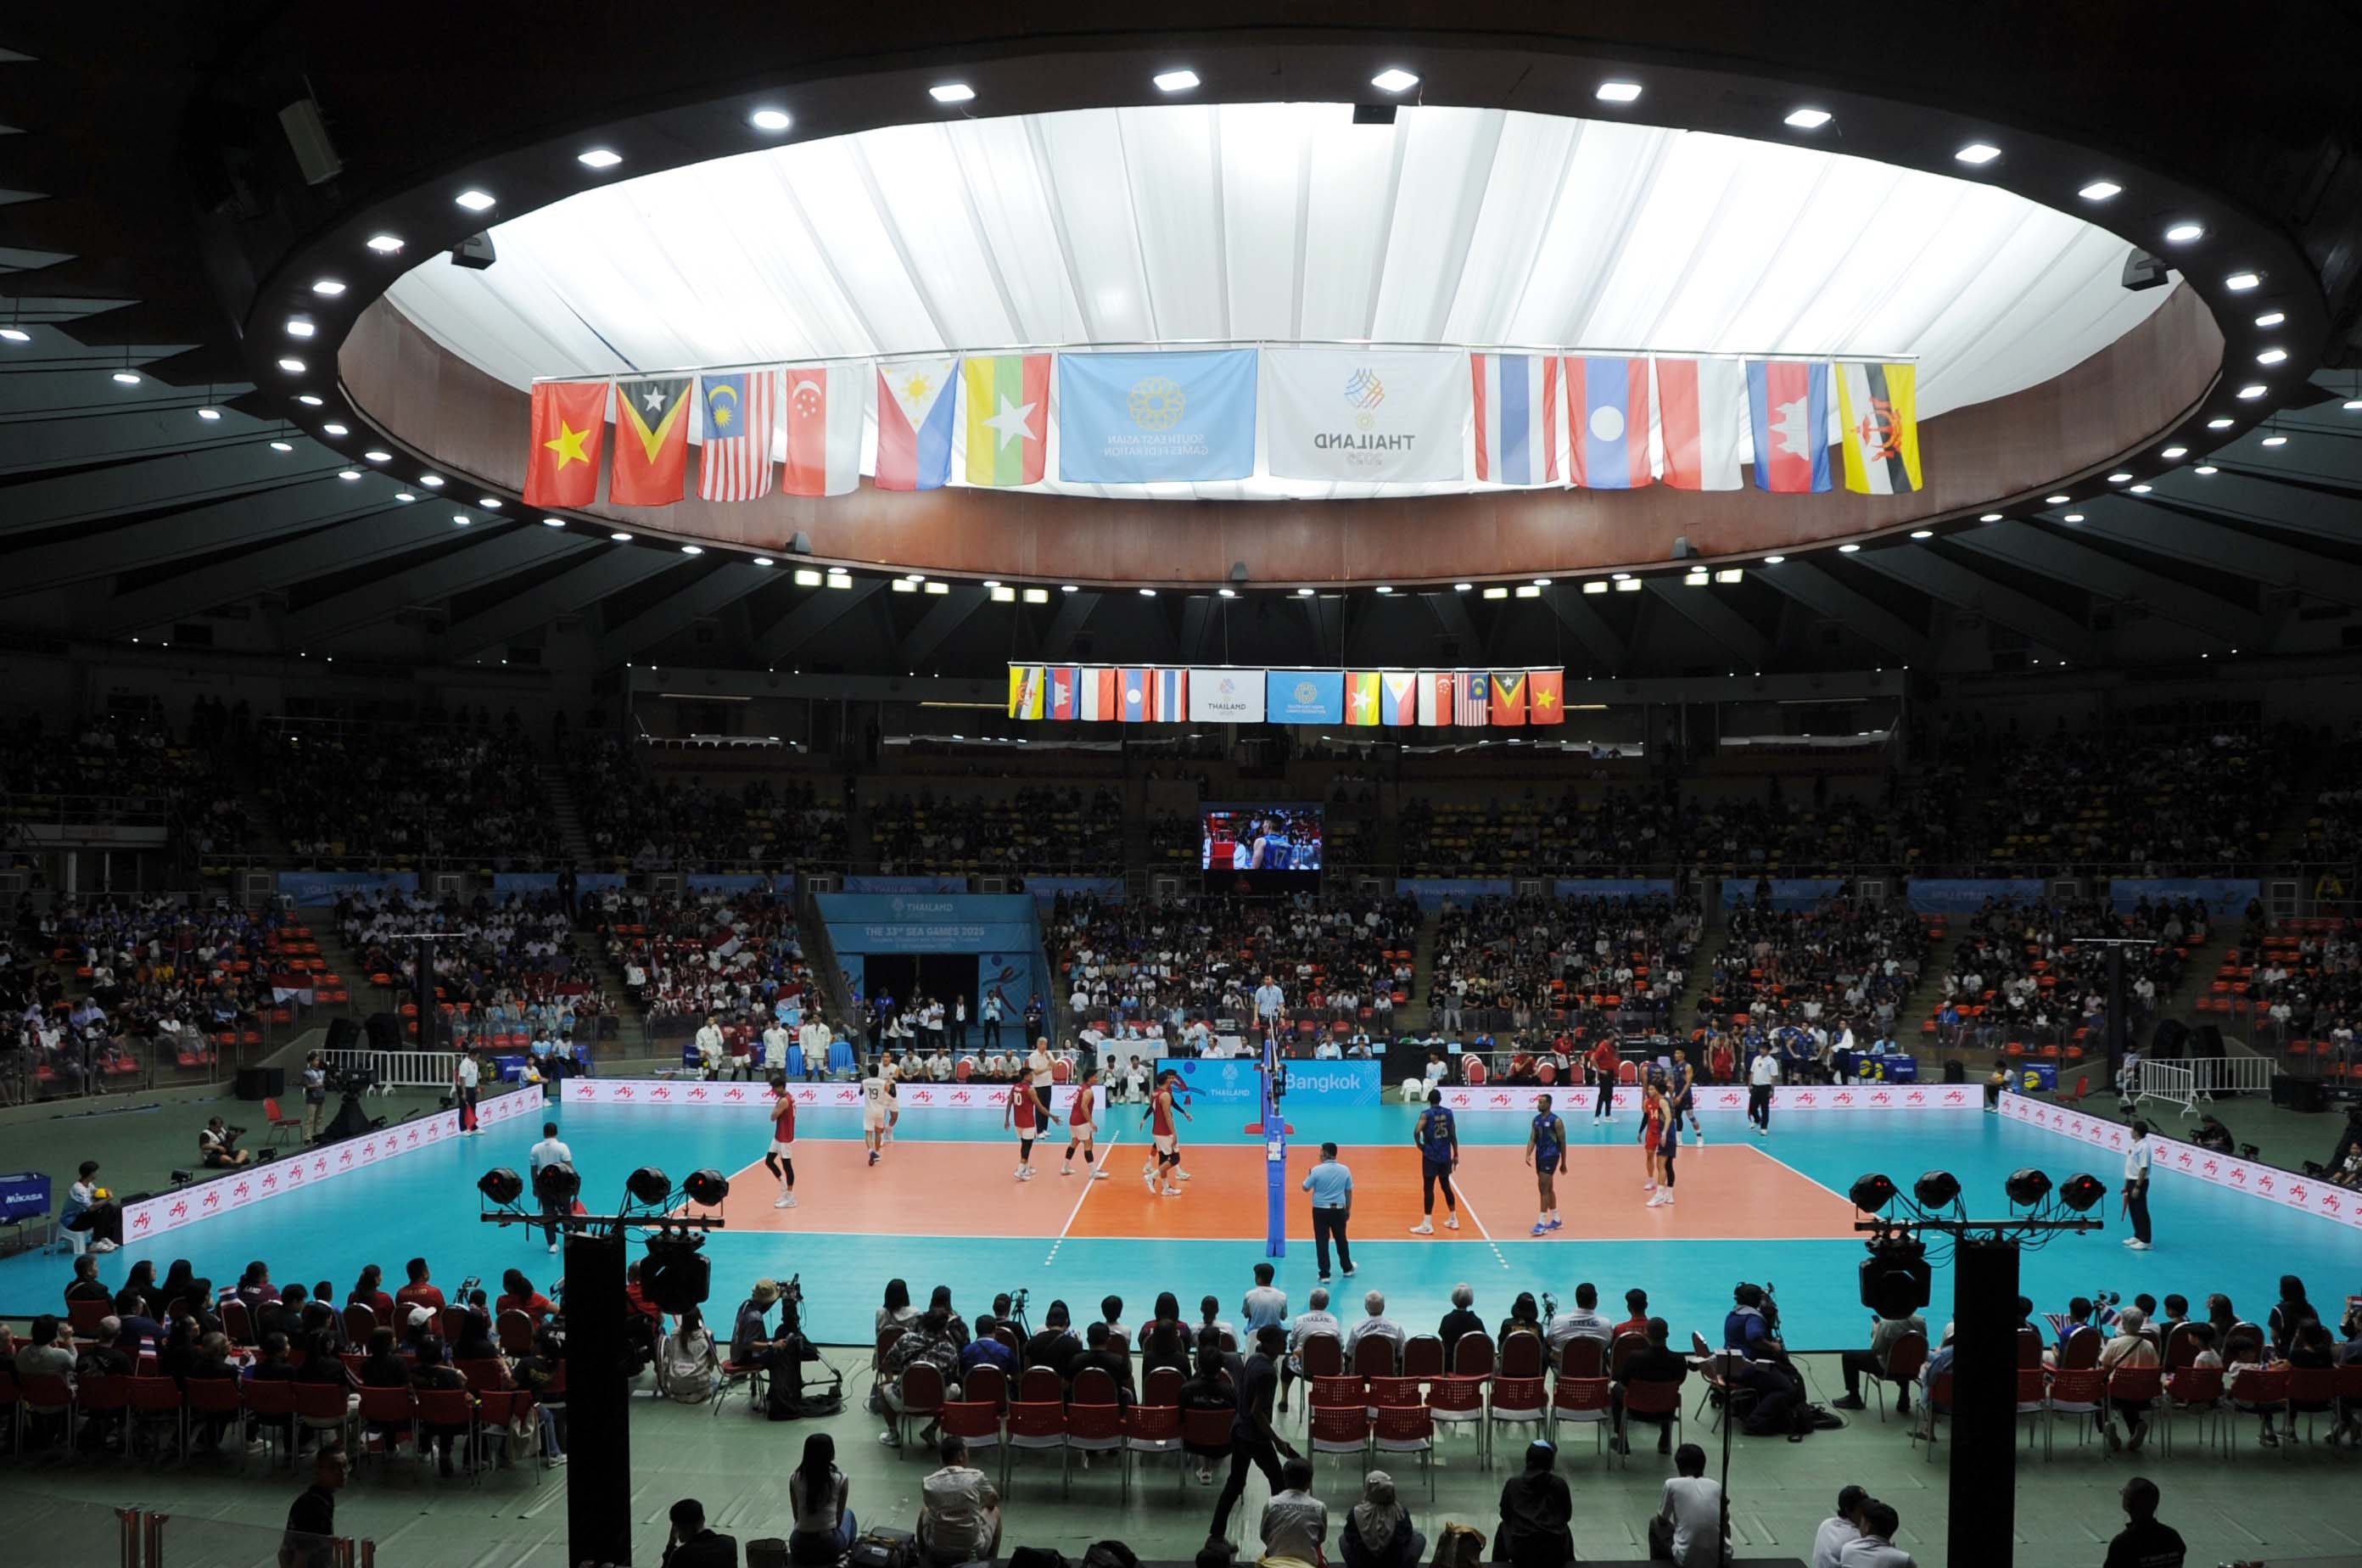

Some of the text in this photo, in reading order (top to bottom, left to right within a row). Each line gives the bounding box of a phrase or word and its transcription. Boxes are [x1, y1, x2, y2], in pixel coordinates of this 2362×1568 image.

[907, 903, 954, 911] THAILAND
[865, 927, 883, 937] THE
[906, 927, 924, 937] SEA
[926, 927, 959, 937] GAMES
[960, 927, 985, 937] 2025
[1285, 1073, 1361, 1093] Bangkok
[869, 1088, 879, 1100] 19
[1211, 1089, 1250, 1097] THAILAND
